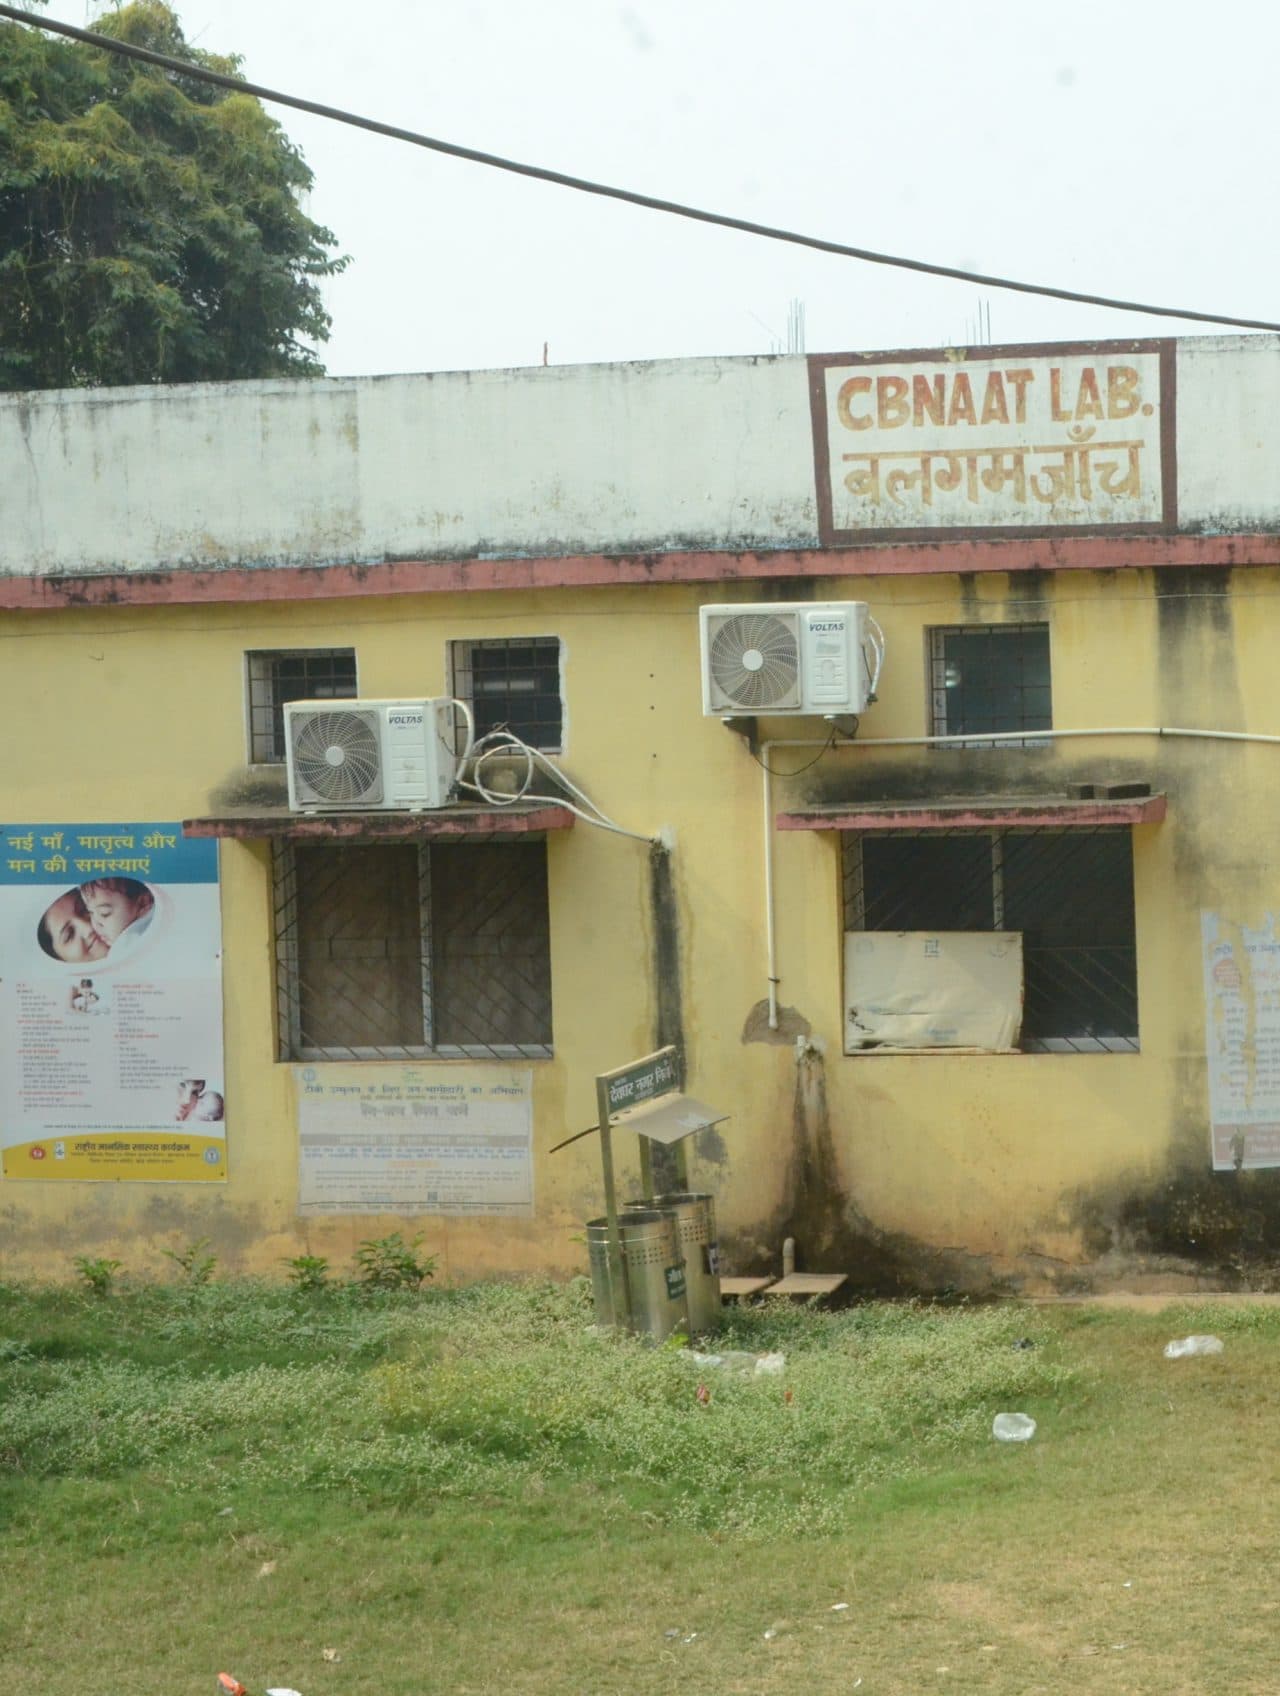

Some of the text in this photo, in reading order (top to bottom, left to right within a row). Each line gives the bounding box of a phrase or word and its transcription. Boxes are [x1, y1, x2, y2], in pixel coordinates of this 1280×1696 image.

[837, 365, 1154, 431] CBNAAT LAB.
[809, 622, 845, 632] VOLTAS
[388, 714, 424, 725] VOLTAS
[7, 831, 34, 852] नई
[76, 834, 134, 854] मातृत्व
[142, 831, 177, 849] और
[8, 858, 36, 873] मन
[43, 855, 68, 873] की
